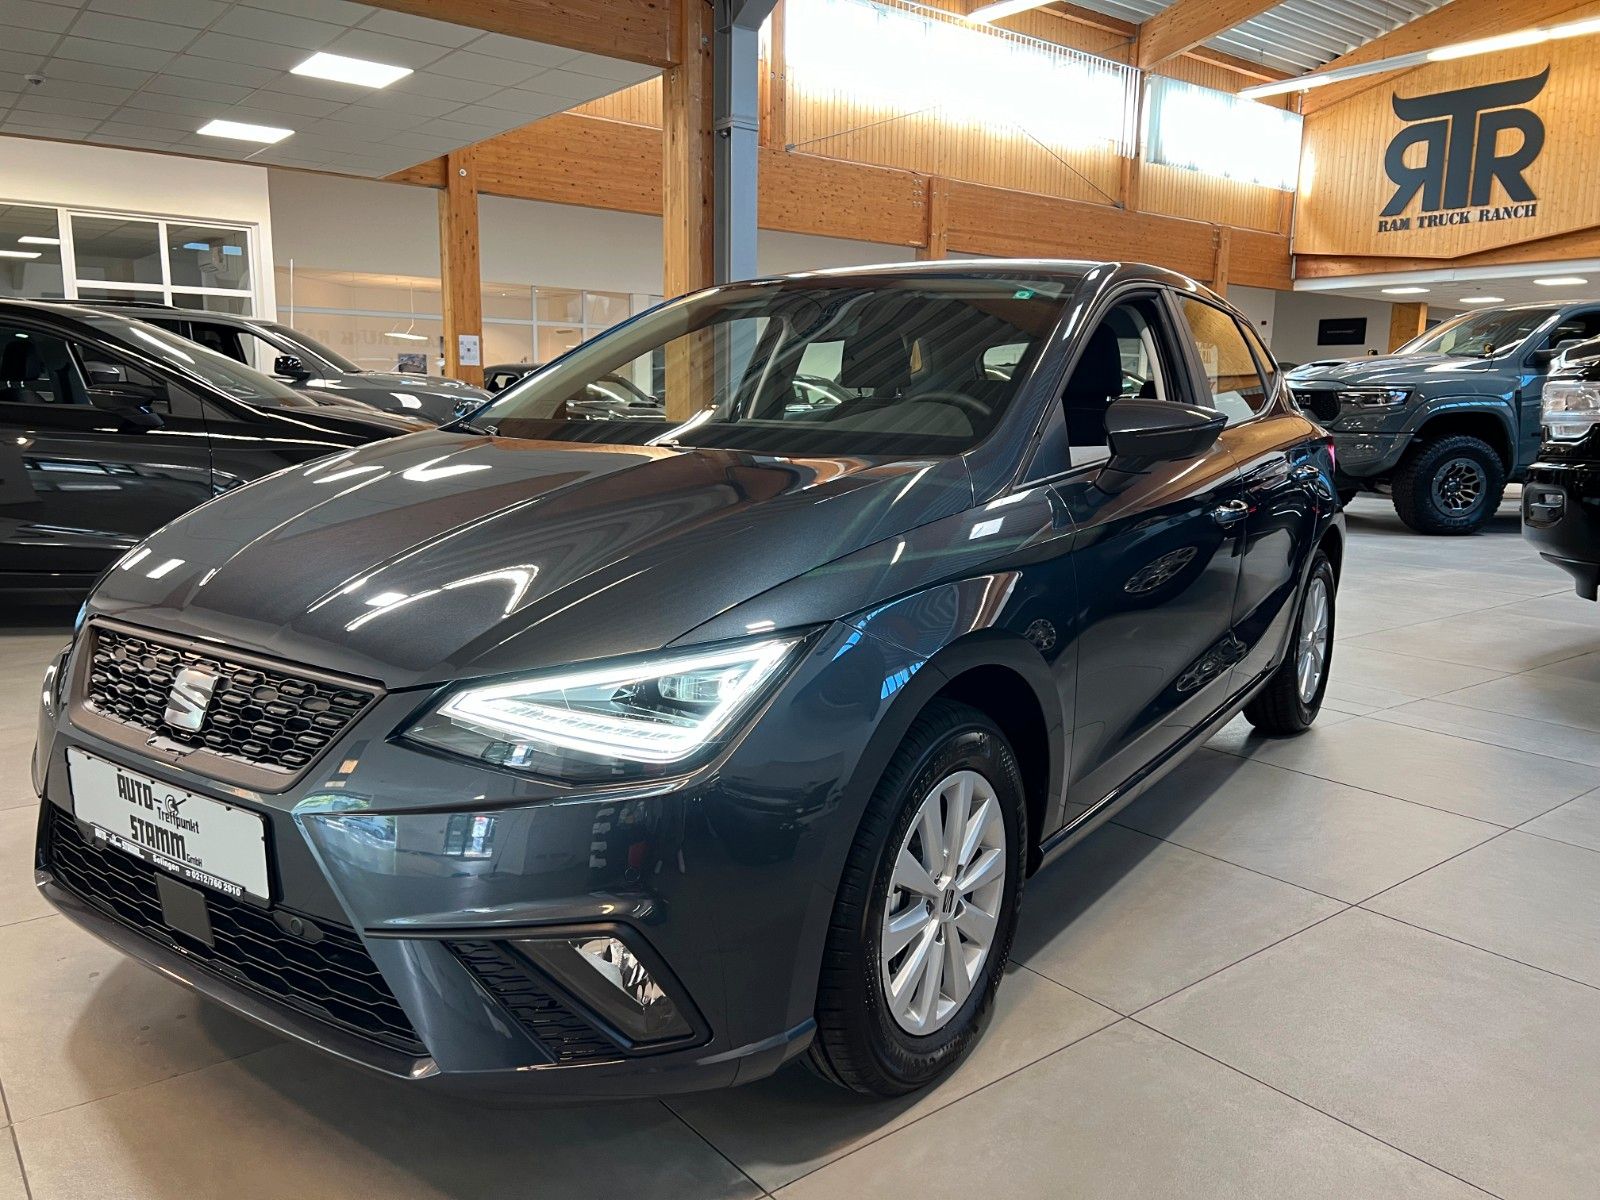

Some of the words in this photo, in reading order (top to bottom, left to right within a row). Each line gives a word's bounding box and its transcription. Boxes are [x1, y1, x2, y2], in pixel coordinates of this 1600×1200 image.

[1378, 217, 1411, 233] RAM
[1417, 210, 1472, 229] TRUCK
[1478, 203, 1538, 222] RANCH
[157, 806, 200, 834] Treffpunkt
[152, 853, 180, 873] Solingen
[222, 881, 241, 897] 2910
